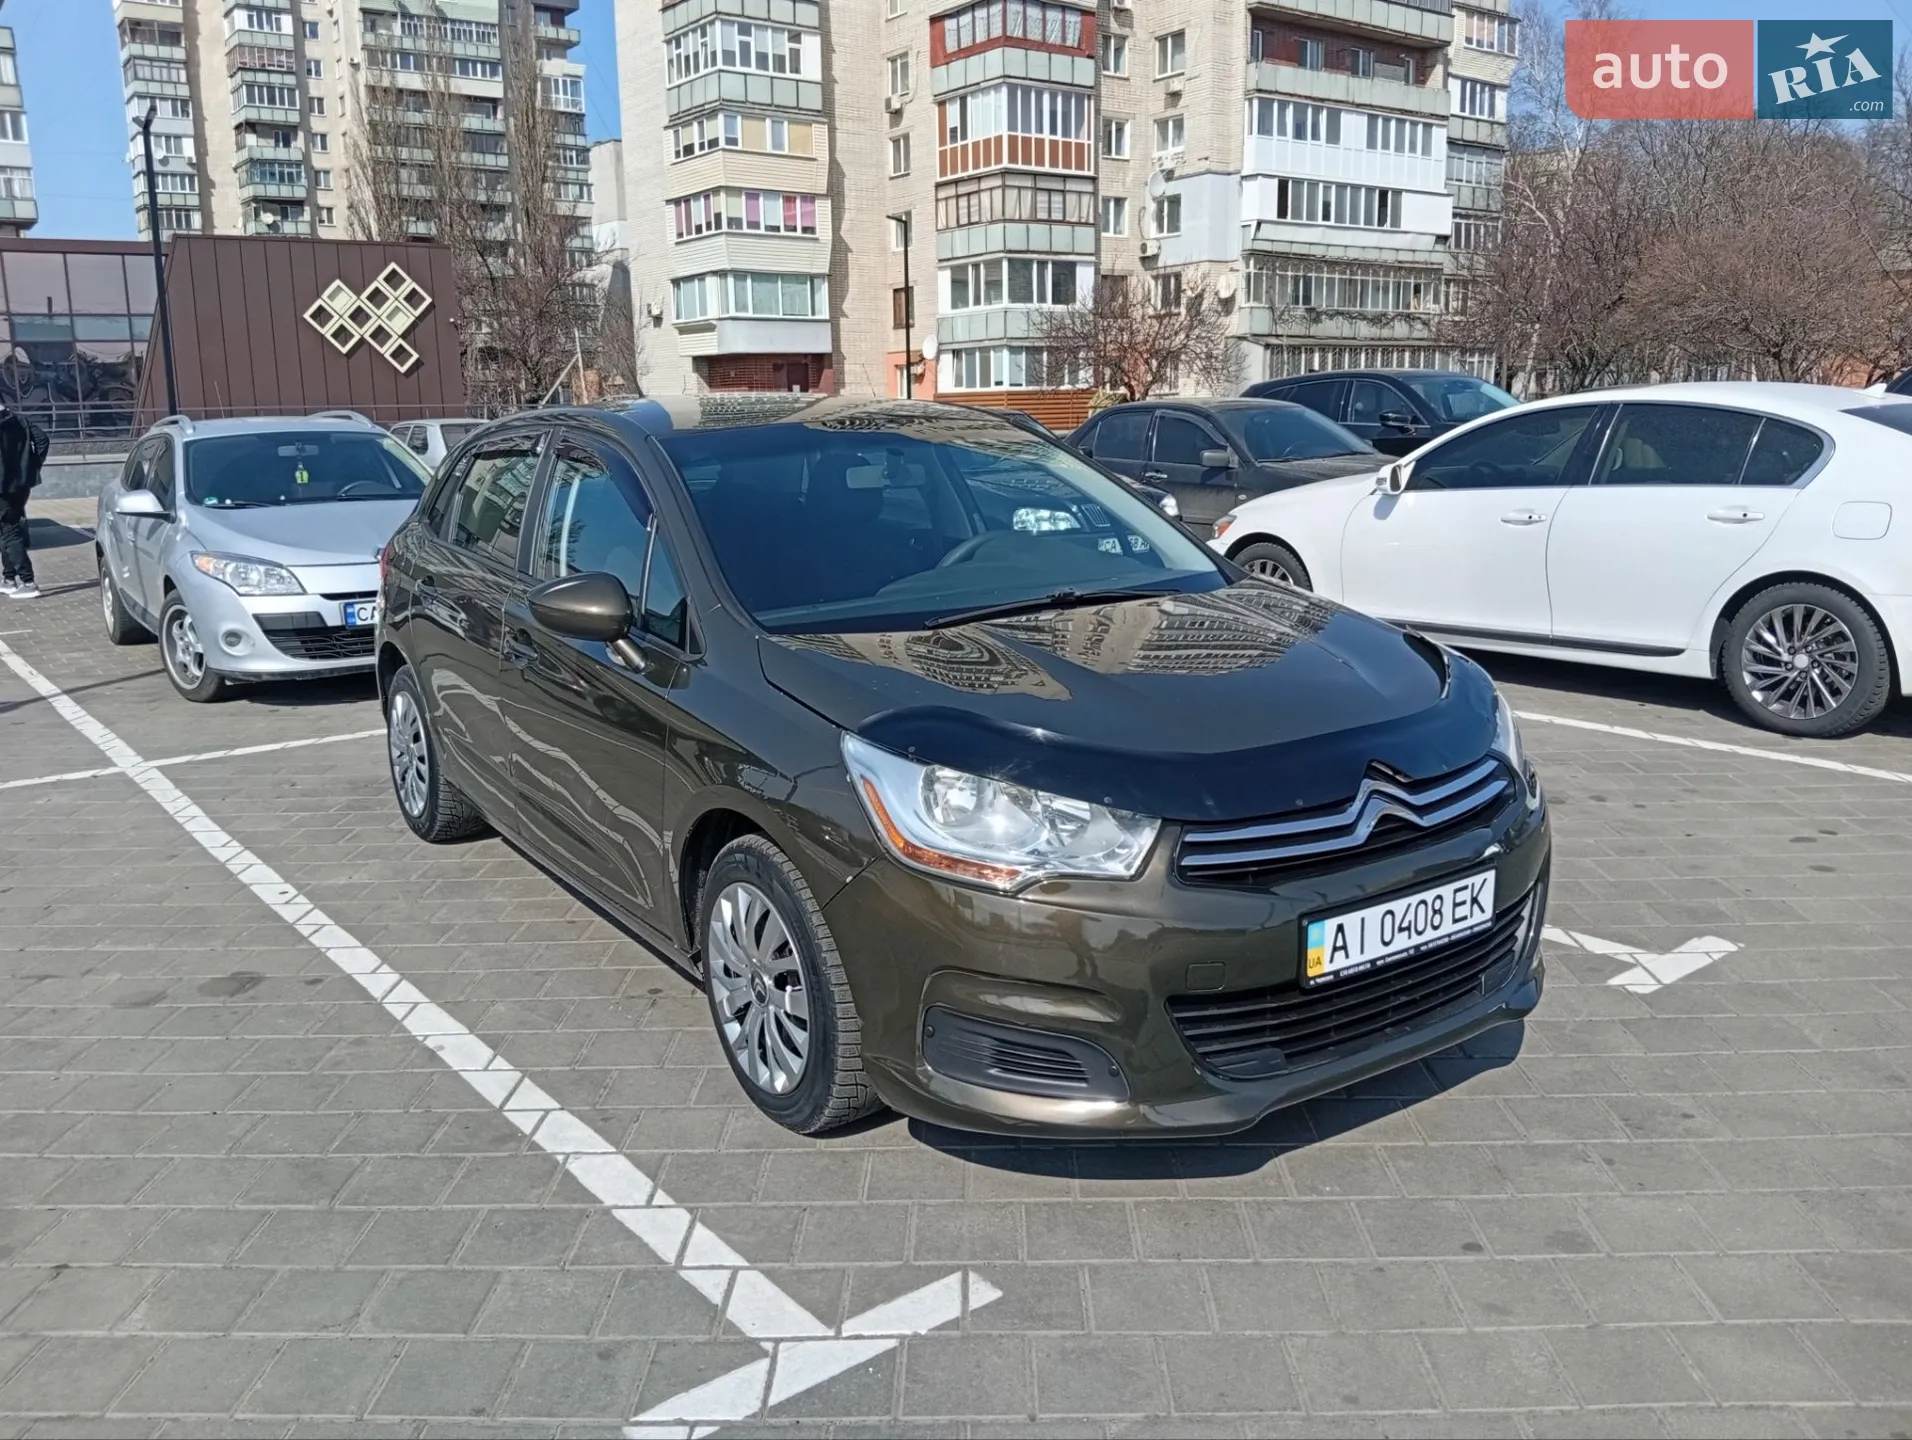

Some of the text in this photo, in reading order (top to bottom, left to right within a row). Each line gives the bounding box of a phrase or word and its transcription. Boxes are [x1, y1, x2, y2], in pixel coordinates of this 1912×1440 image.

[1329, 916, 1366, 964] AI
[1380, 894, 1444, 947] 0408
[1451, 878, 1488, 925] EK
[1308, 956, 1322, 969] UA
